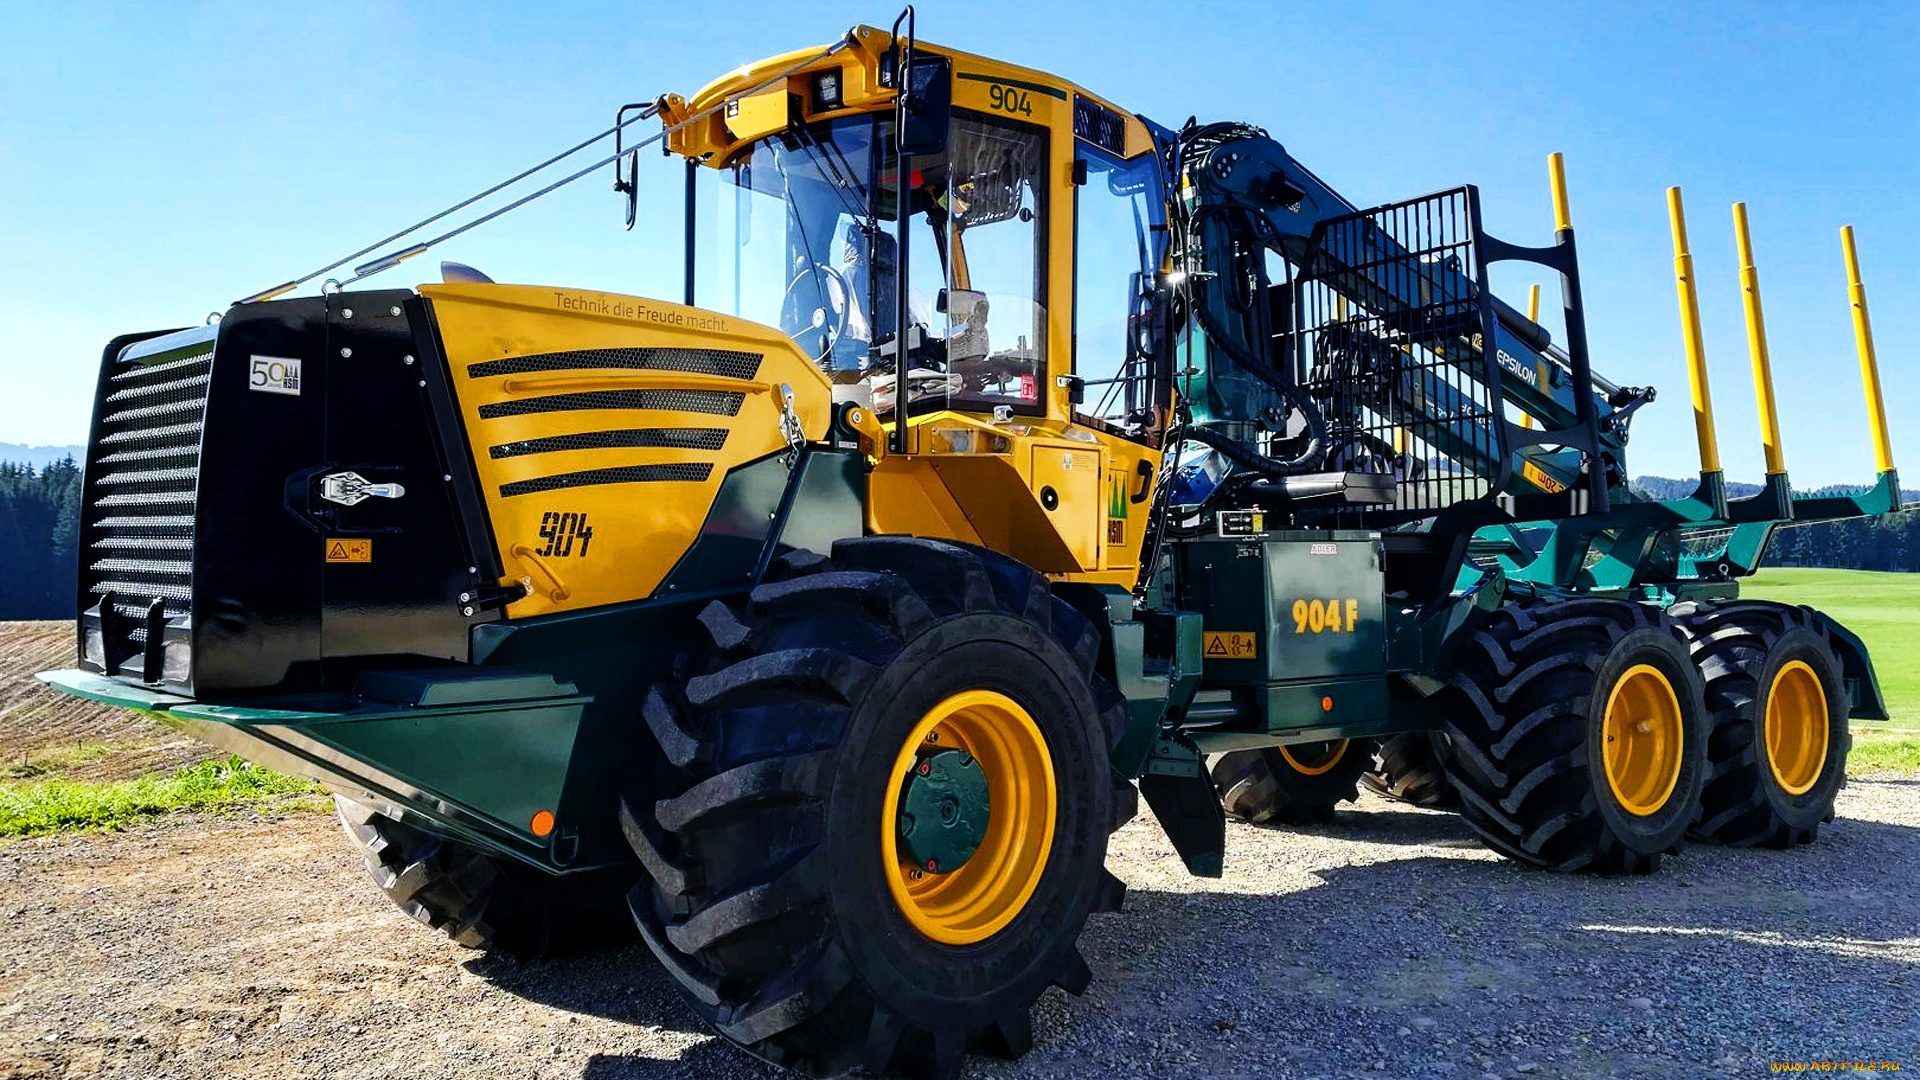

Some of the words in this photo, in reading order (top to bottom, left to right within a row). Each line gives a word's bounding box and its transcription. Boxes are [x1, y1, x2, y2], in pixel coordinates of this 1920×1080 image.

[989, 84, 1032, 117] 904
[554, 292, 609, 315] Technik
[613, 302, 634, 318] die
[637, 305, 683, 325] Freude
[686, 315, 729, 332] macht.
[252, 360, 285, 387] 50
[1496, 350, 1536, 386] EPSILON
[536, 511, 593, 557] 904
[1292, 598, 1342, 634] 904
[1345, 598, 1358, 633] F
